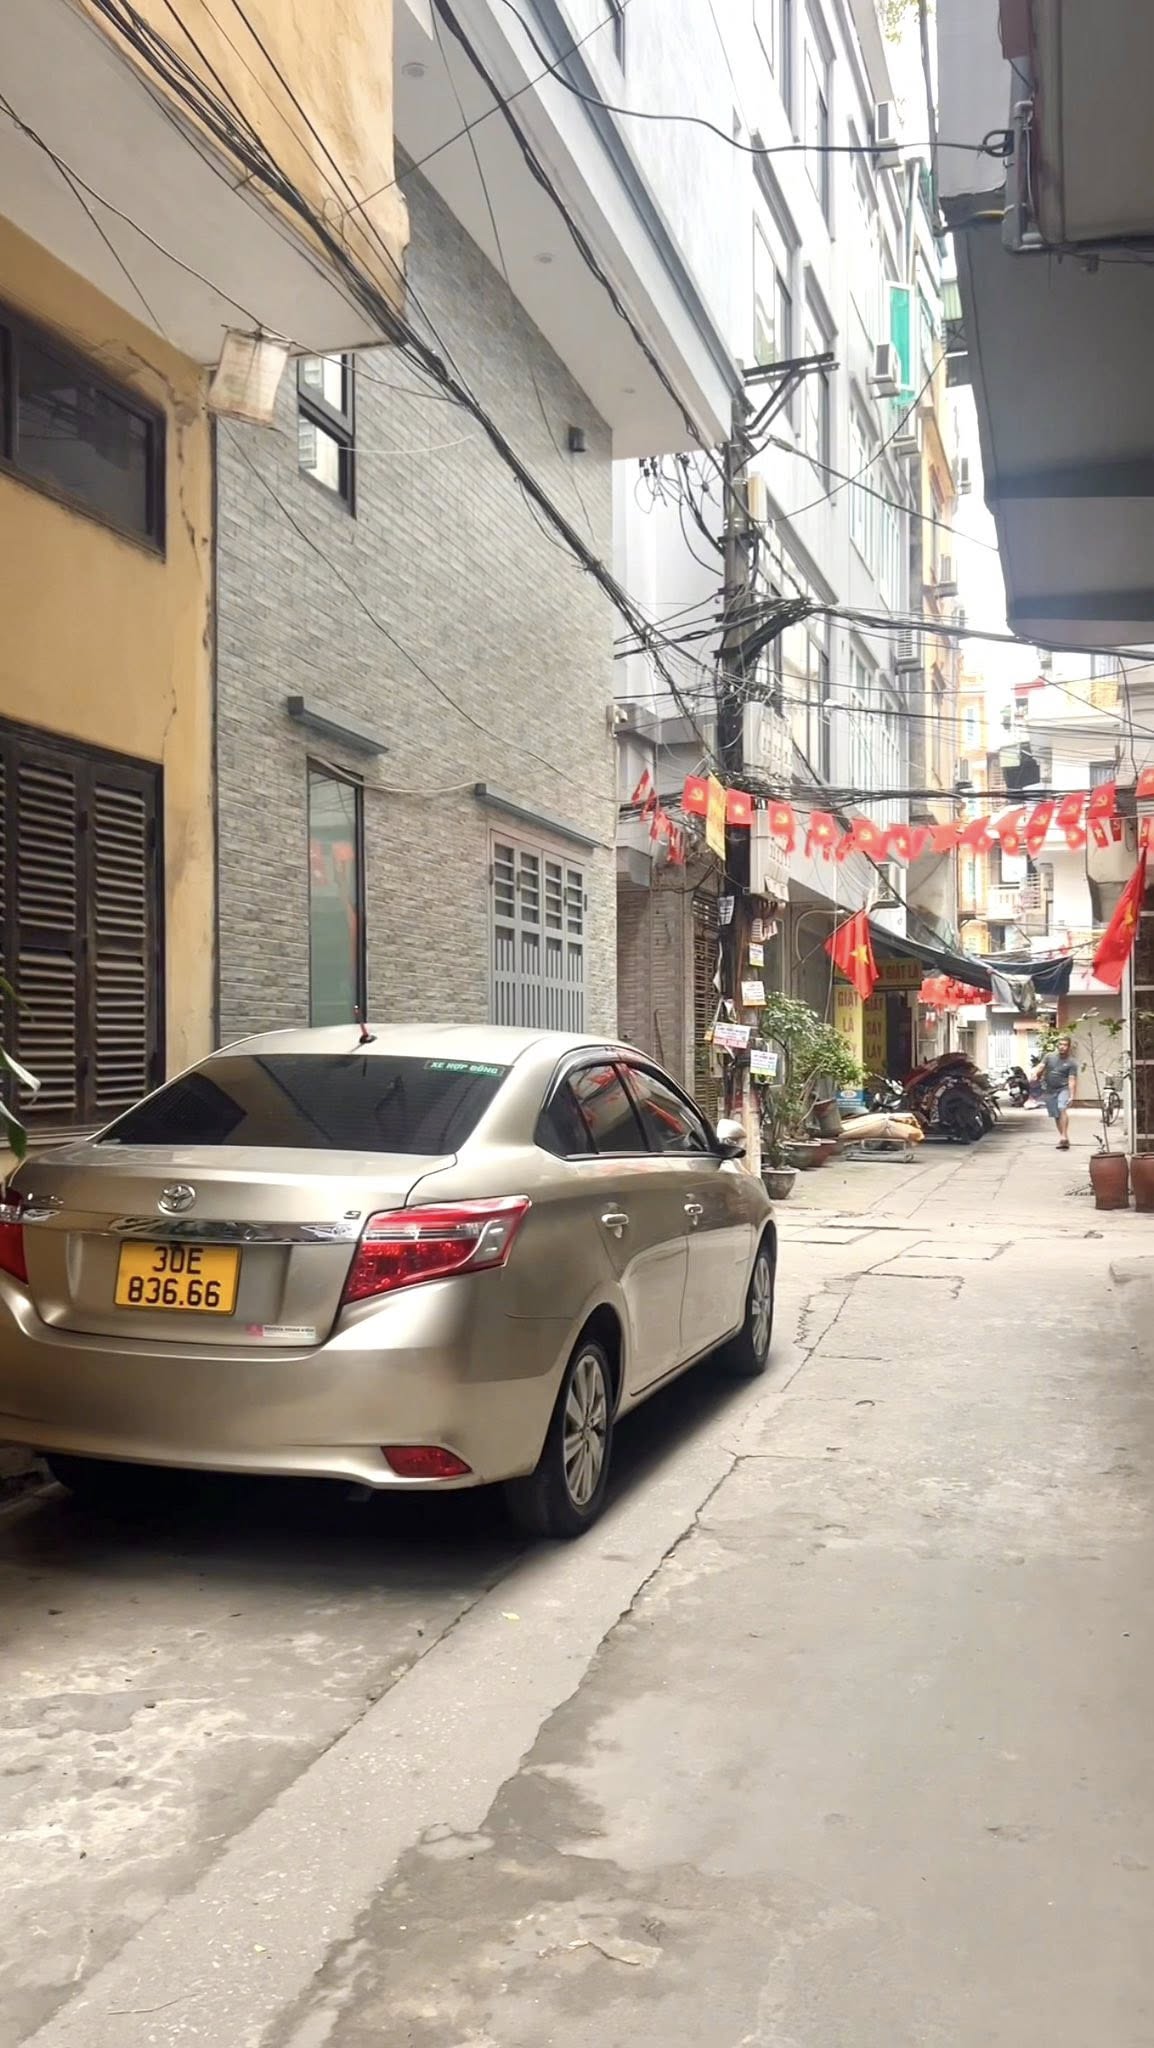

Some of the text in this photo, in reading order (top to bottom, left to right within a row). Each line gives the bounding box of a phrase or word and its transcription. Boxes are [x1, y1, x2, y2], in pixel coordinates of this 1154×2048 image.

[430, 1061, 446, 1069] XE
[152, 1246, 204, 1274] 30E
[128, 1276, 221, 1307] 836.66
